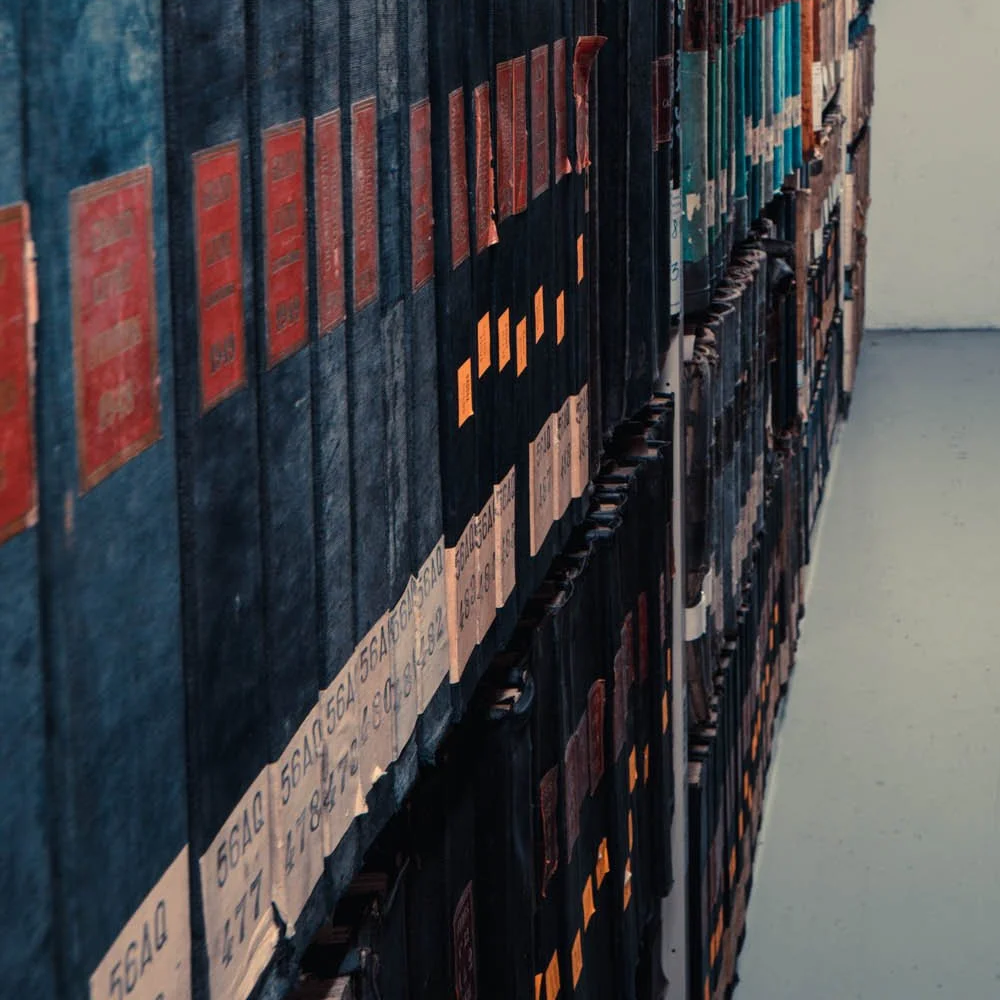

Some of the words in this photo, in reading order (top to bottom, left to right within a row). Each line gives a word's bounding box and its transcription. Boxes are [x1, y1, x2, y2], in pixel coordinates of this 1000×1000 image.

[281, 719, 325, 805] 56AQ
[216, 791, 265, 888] 56AQ
[285, 788, 323, 875] 478
[109, 899, 168, 1000] 56AQ
[221, 869, 264, 968] 477
